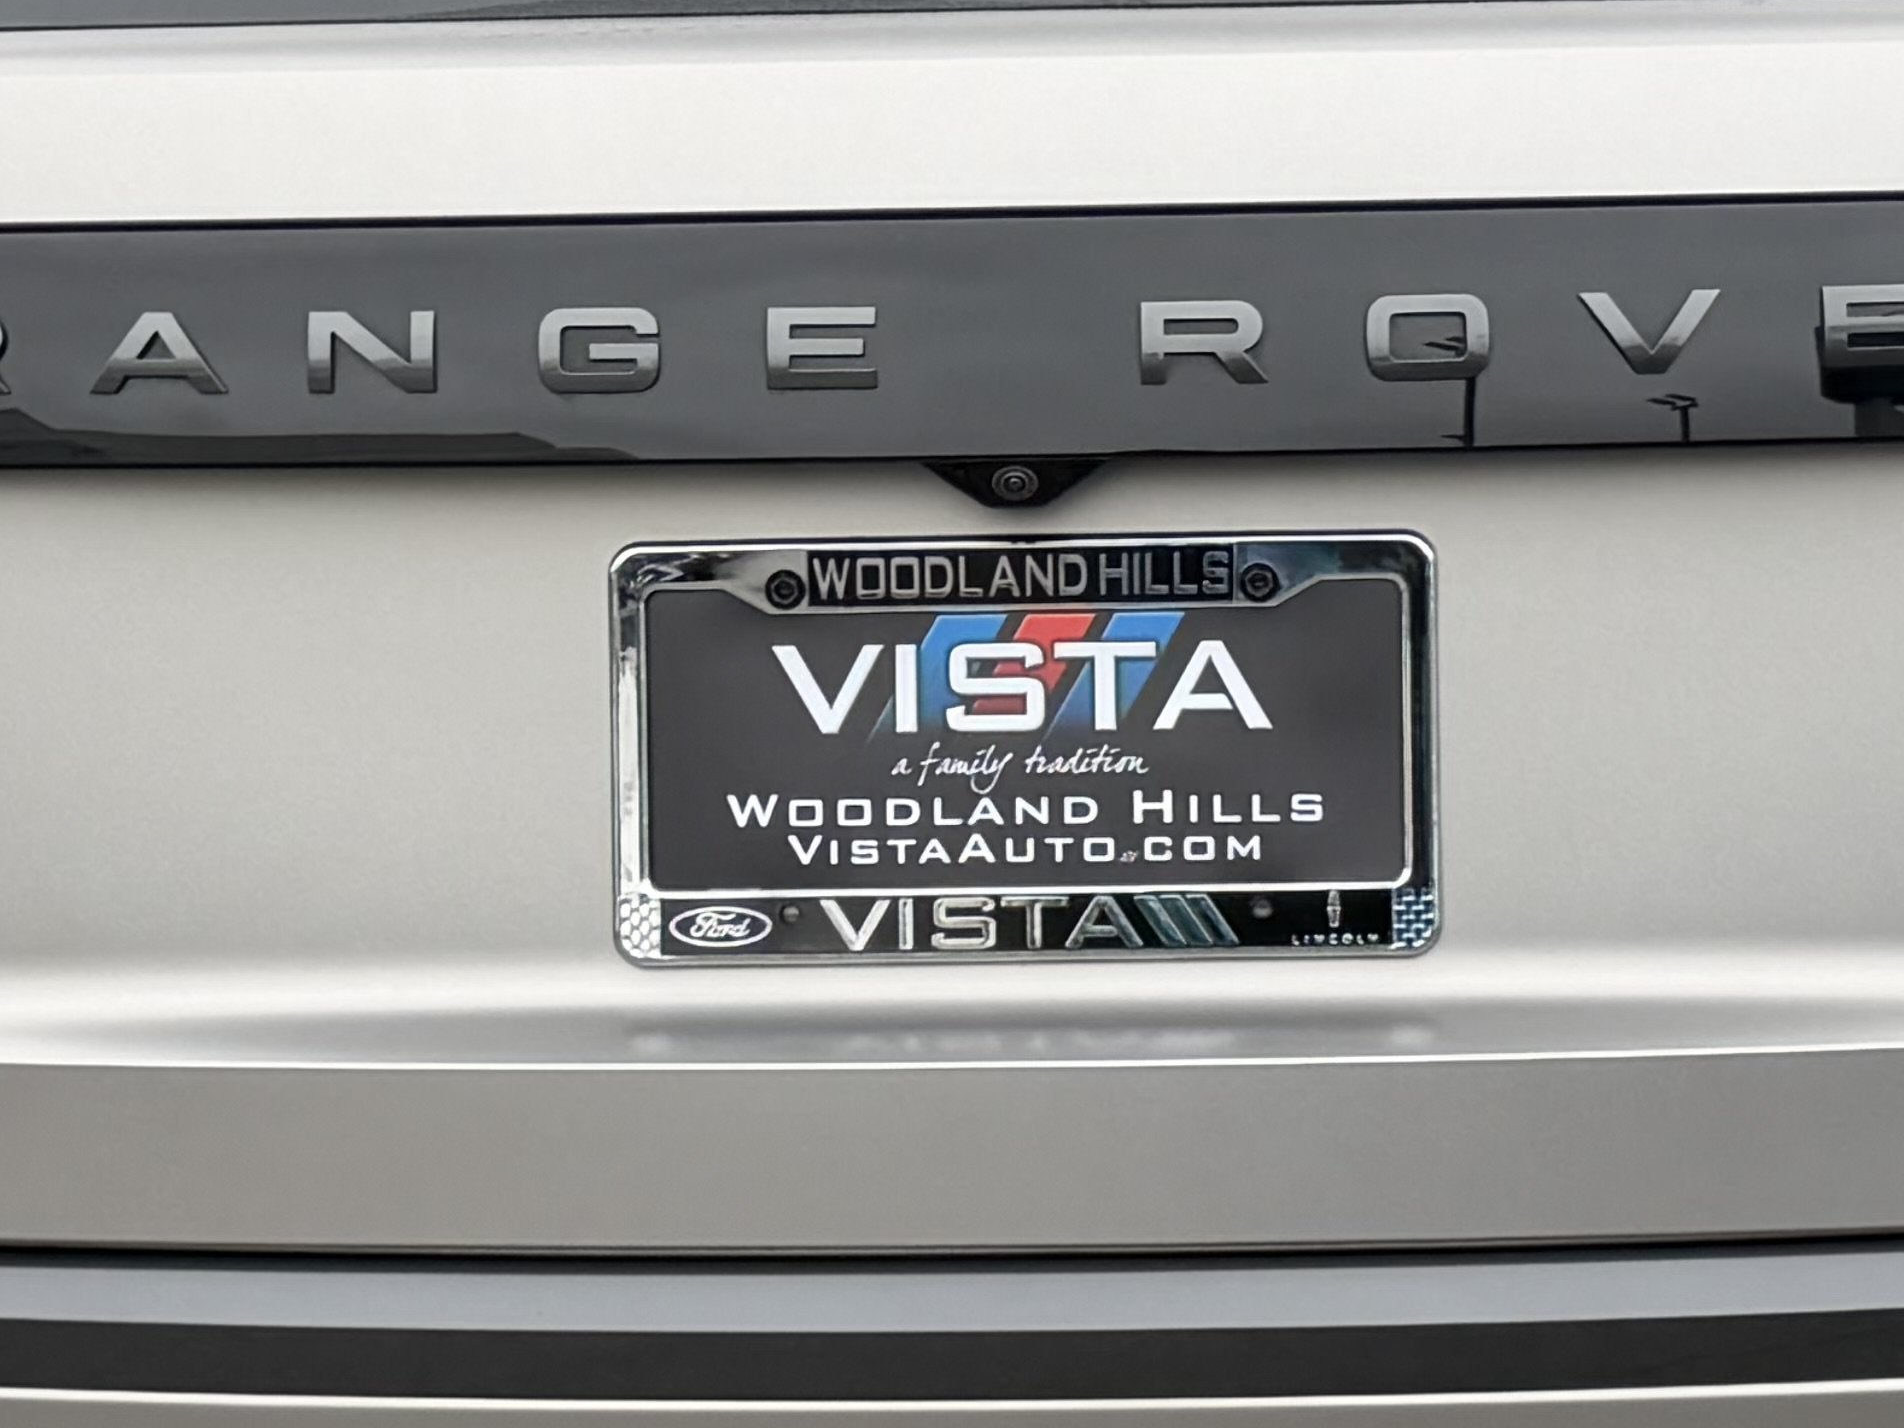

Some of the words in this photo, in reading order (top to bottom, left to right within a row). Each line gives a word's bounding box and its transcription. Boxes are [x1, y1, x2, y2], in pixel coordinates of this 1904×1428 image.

[812, 551, 1089, 601] WOODLAND
[1098, 550, 1231, 596] HILLS
[770, 639, 1274, 735] VISTA
[891, 757, 913, 775] a
[917, 741, 1013, 794] family
[1025, 743, 1150, 775] tradition
[689, 911, 752, 939] Ford
[819, 894, 1145, 952] VISTA
